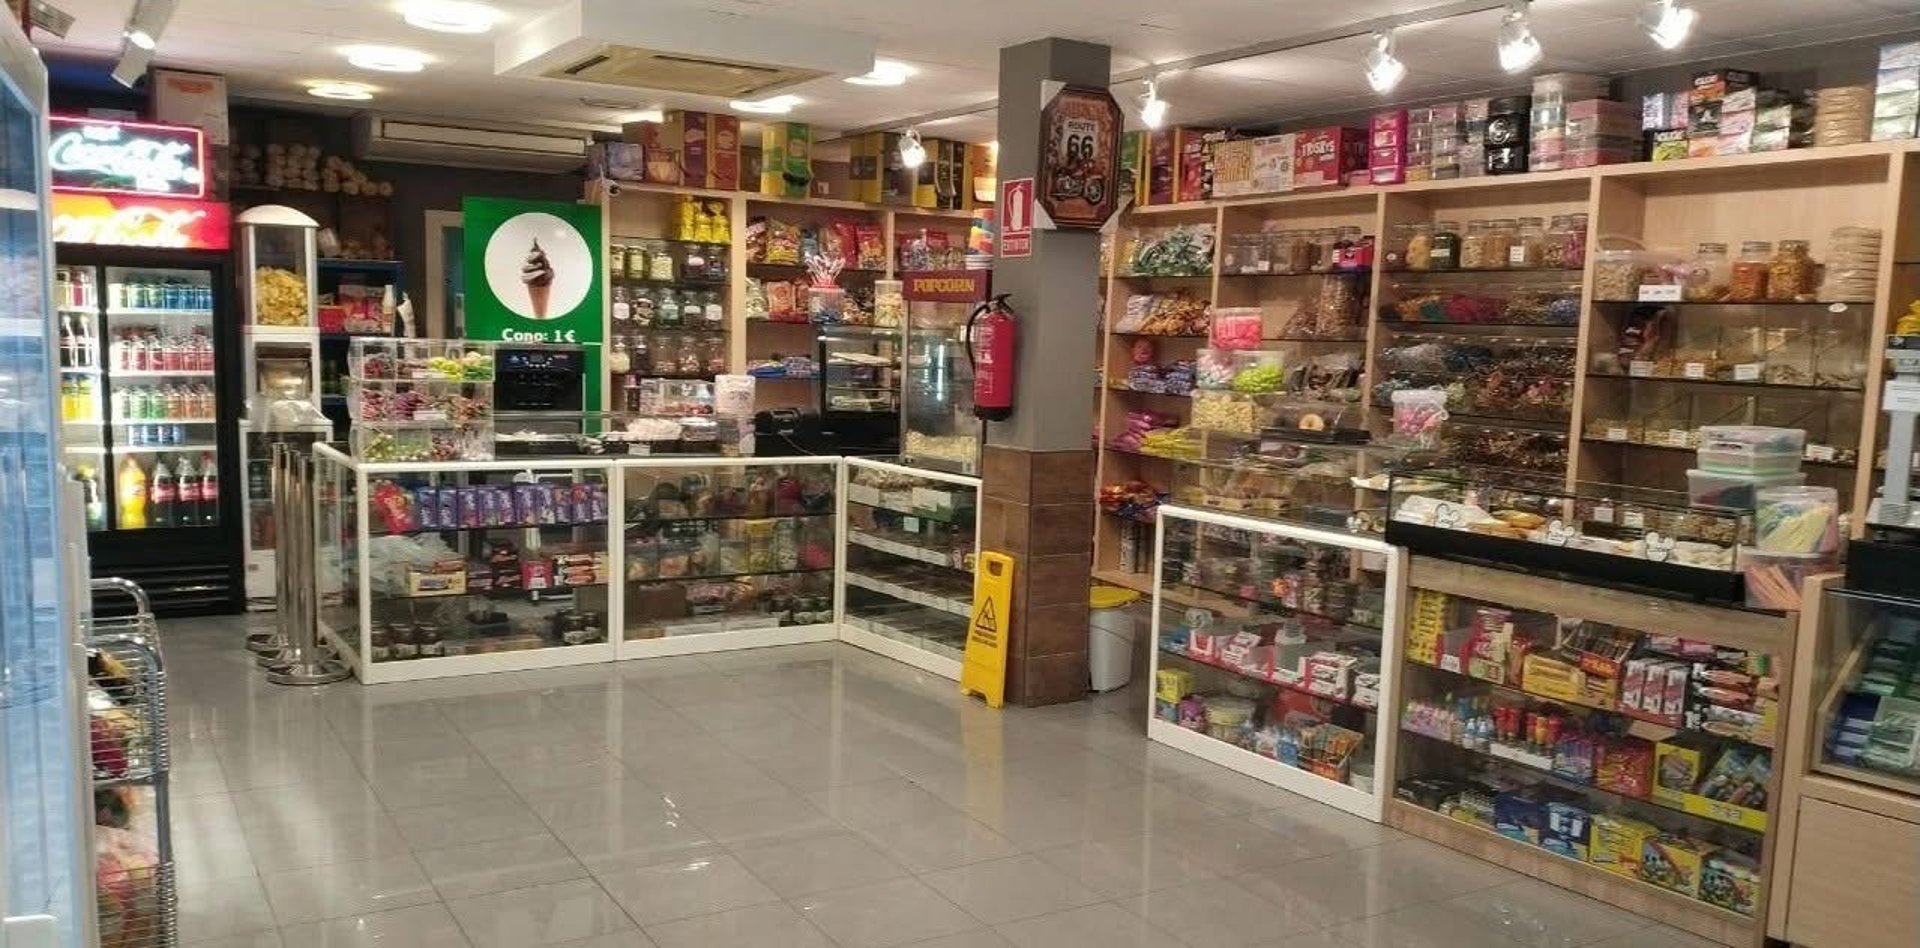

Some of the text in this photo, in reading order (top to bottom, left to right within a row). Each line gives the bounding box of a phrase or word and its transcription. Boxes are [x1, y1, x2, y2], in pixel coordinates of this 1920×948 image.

[1067, 134, 1094, 159] 66
[912, 278, 975, 293] POPCORN
[501, 327, 549, 343] Cono:
